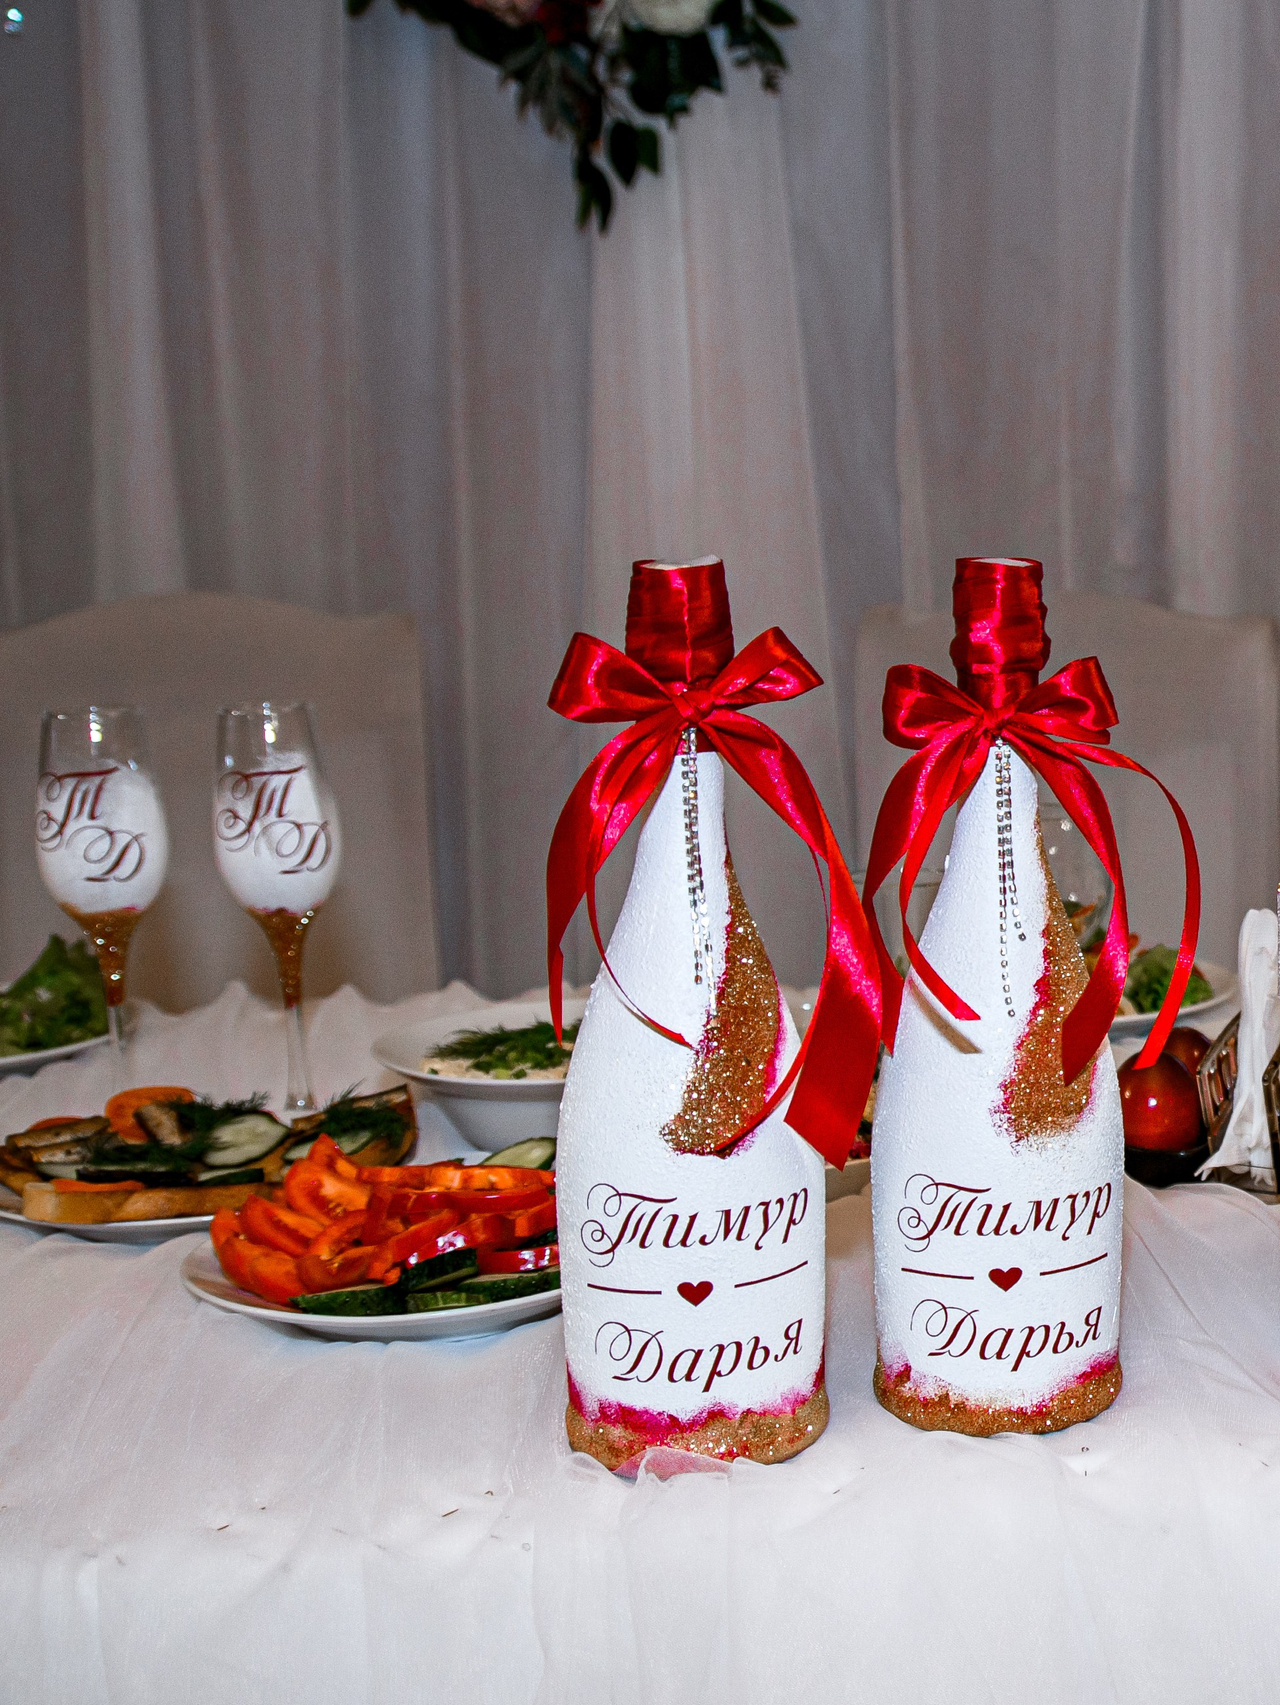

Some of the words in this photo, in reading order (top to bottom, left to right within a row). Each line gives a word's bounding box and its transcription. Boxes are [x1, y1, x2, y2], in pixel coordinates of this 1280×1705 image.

[581, 1183, 808, 1268] Тимур
[898, 1174, 1112, 1252] Тимур
[595, 1319, 803, 1393] Дарья
[910, 1299, 1102, 1372] Дарья
